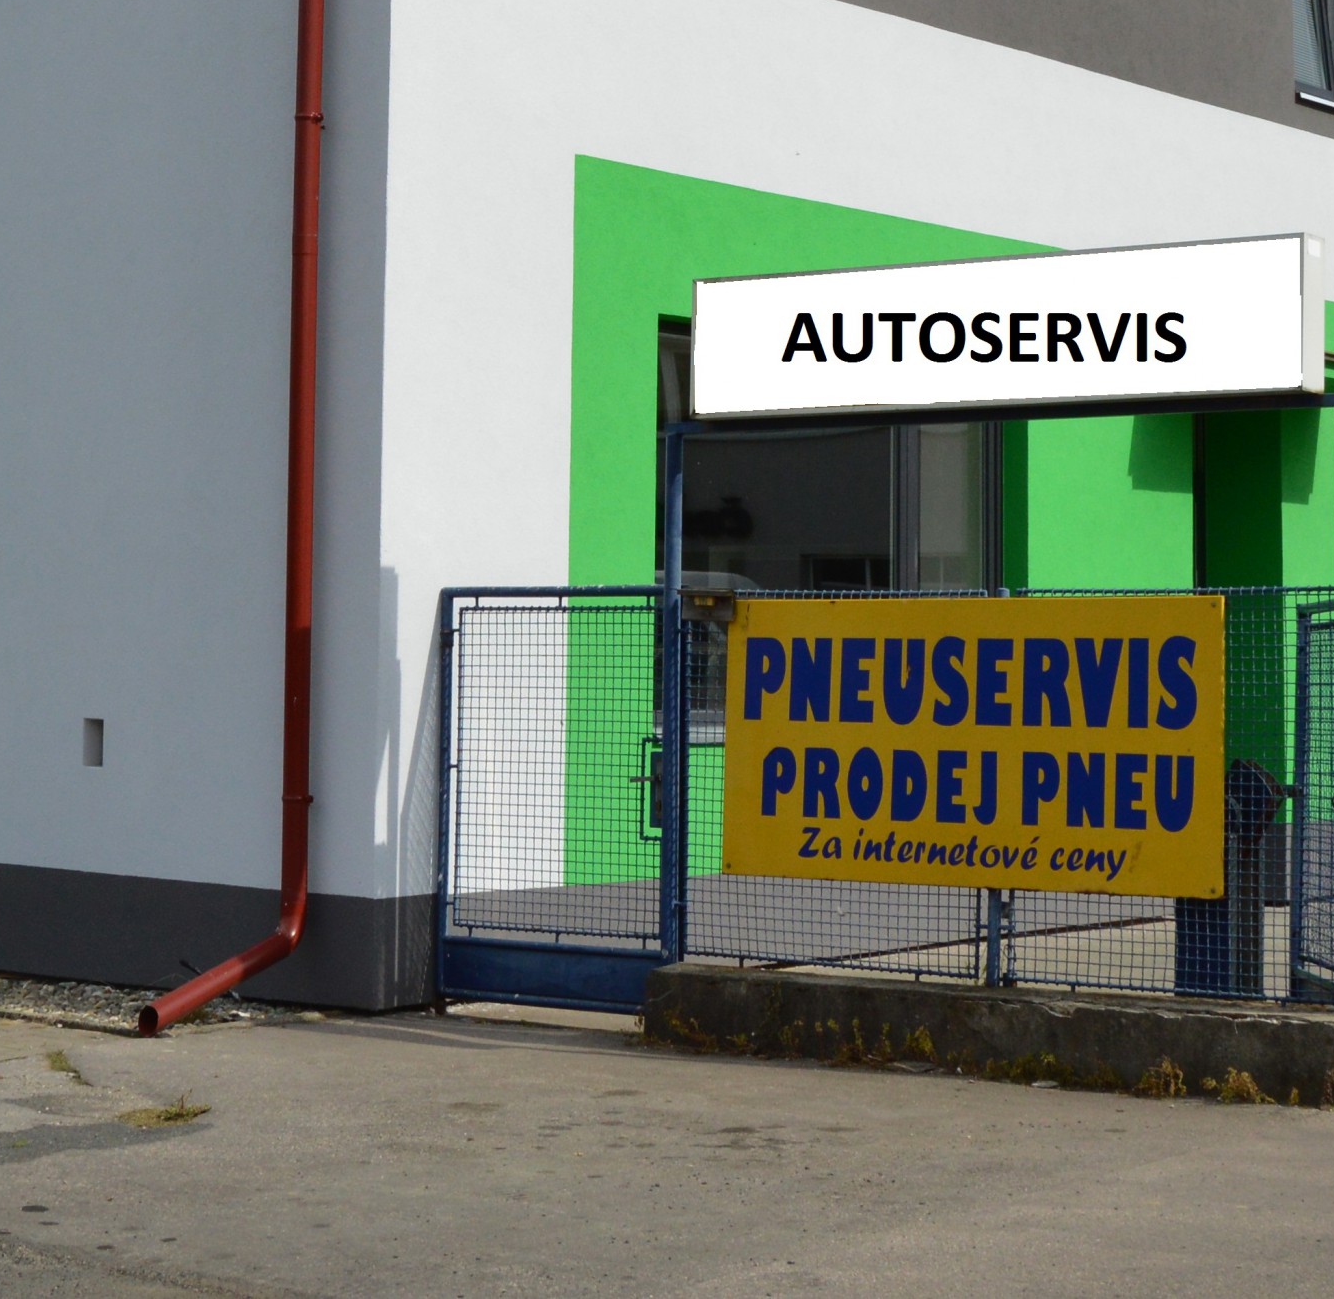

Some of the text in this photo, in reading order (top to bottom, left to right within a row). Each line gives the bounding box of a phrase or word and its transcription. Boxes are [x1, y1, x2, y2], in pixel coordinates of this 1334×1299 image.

[781, 311, 1188, 364] AUTOSERVIS
[743, 635, 1198, 731] PNEUSERVIS
[760, 746, 1196, 833] PRODEJ PNEU
[797, 826, 1128, 882] Za internetové ceny
